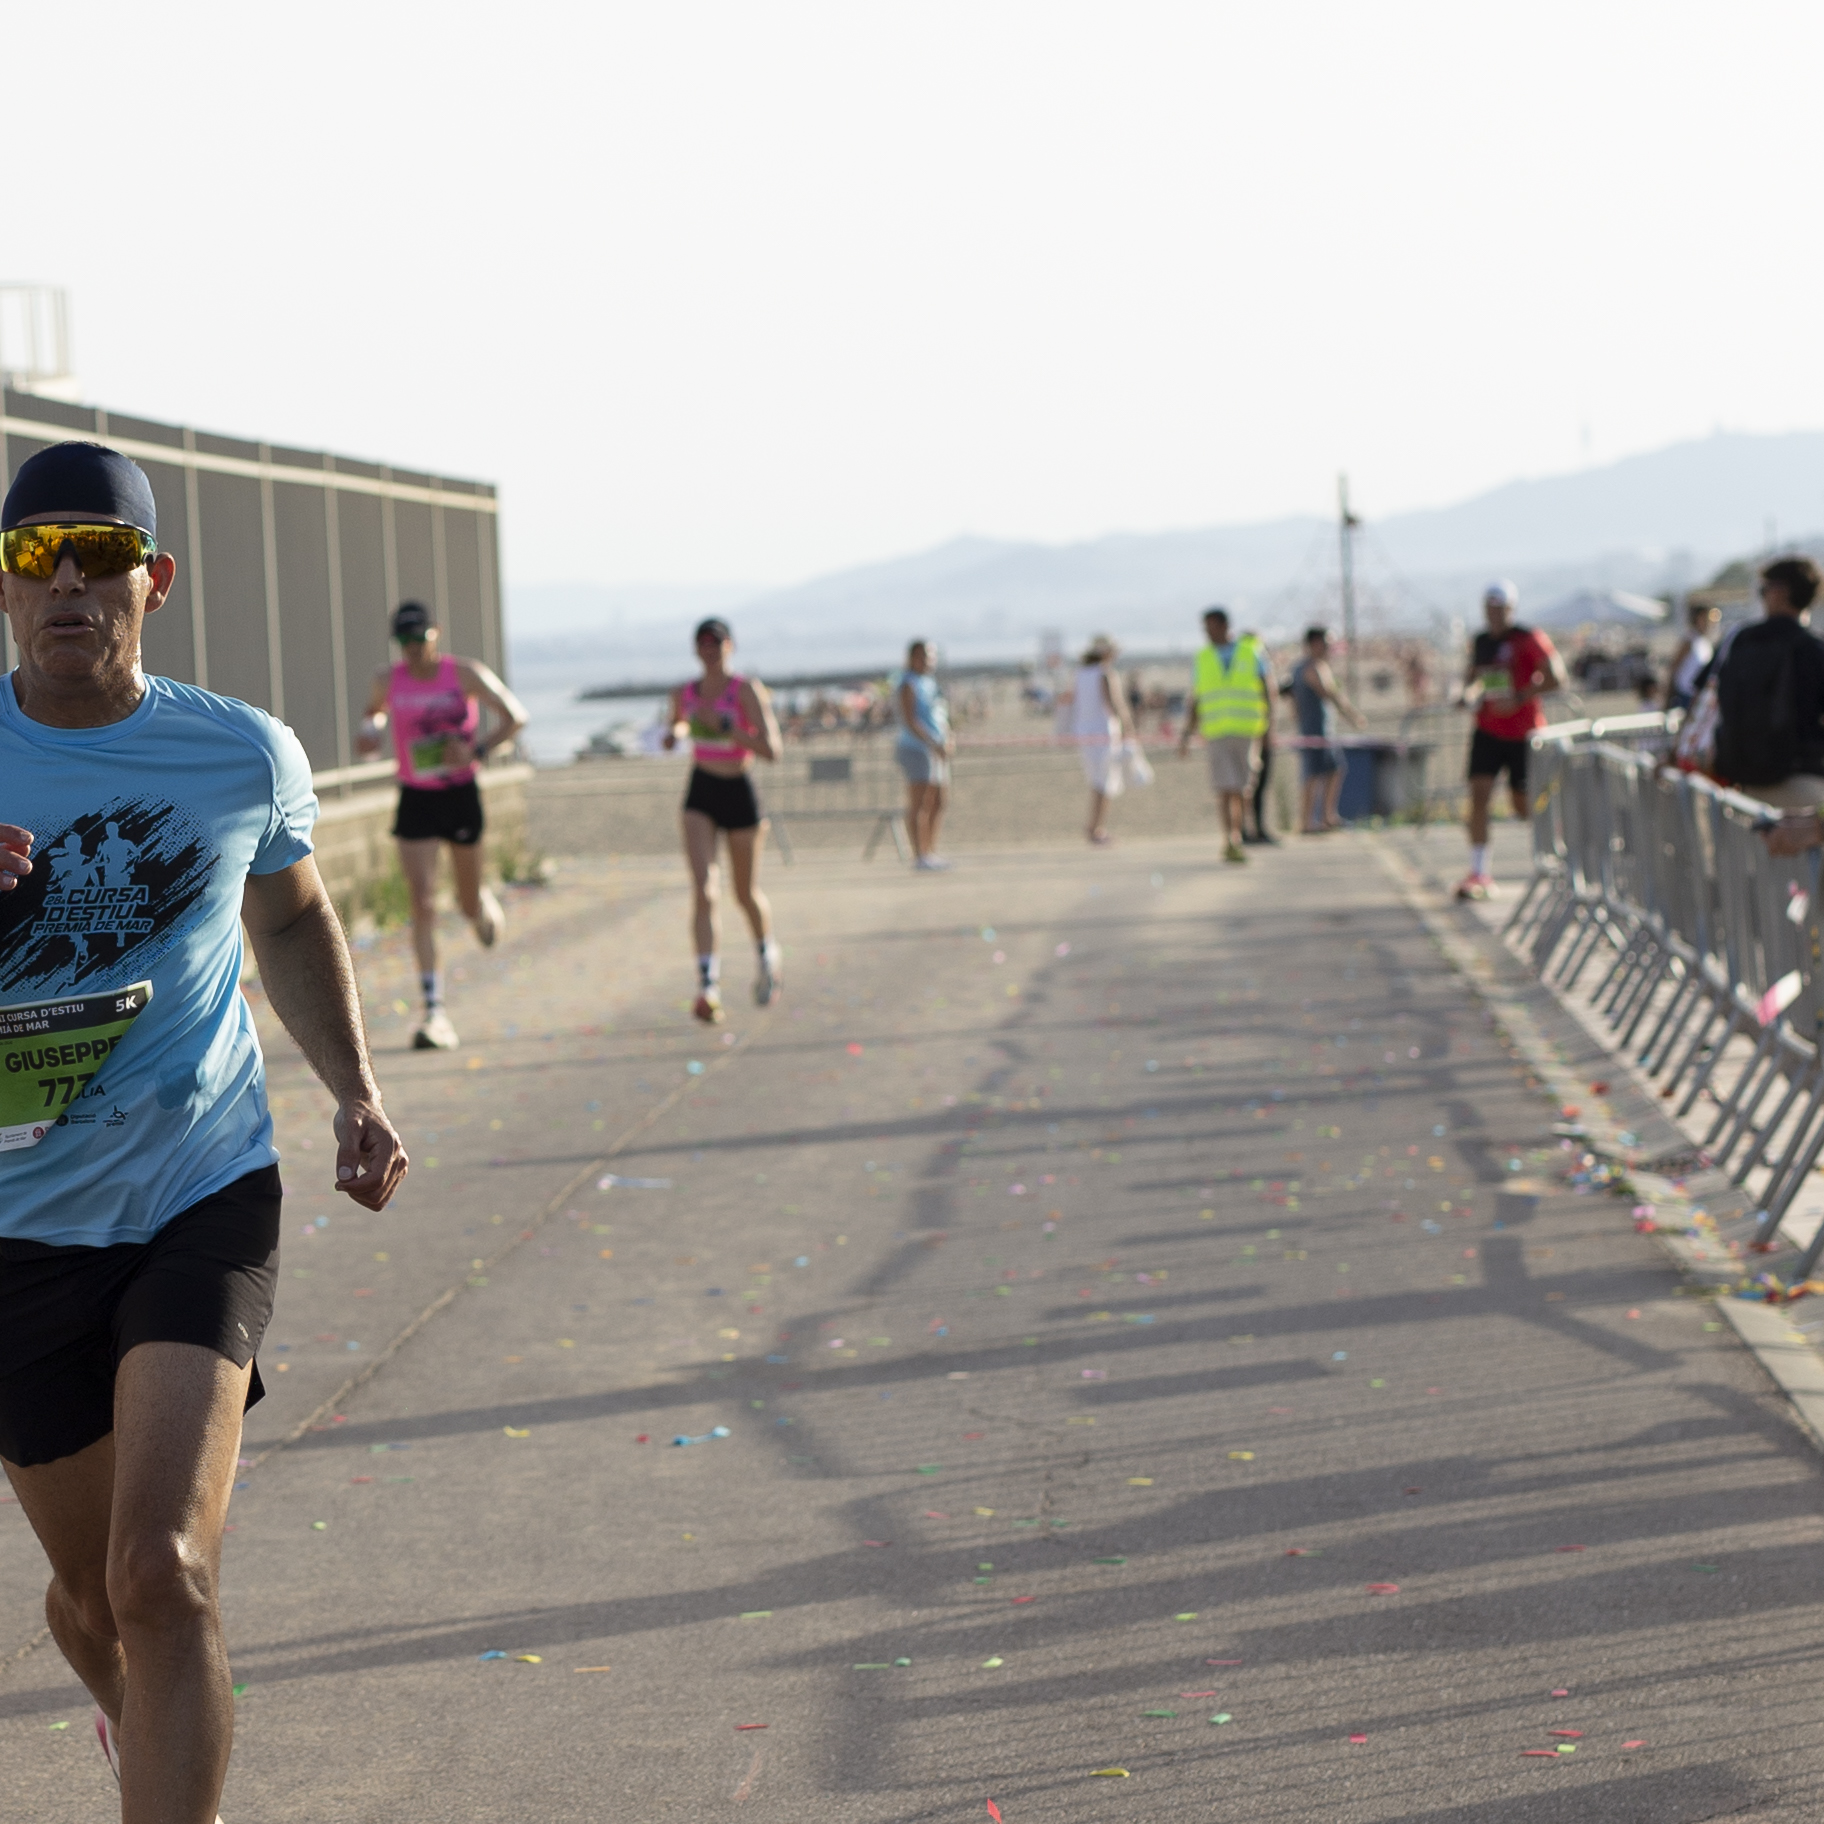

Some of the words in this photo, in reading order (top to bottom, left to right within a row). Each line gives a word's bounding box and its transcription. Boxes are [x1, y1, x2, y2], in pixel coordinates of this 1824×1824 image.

[67, 886, 147, 905] CURSA
[46, 904, 135, 922] D'ESTIU
[94, 920, 115, 931] DE
[116, 920, 152, 931] MAR
[6, 1010, 38, 1022] CURSA
[40, 1003, 85, 1018] D'ESTIU
[115, 994, 138, 1013] 5K
[13, 1023, 24, 1033] DE
[26, 1019, 50, 1032] MAR
